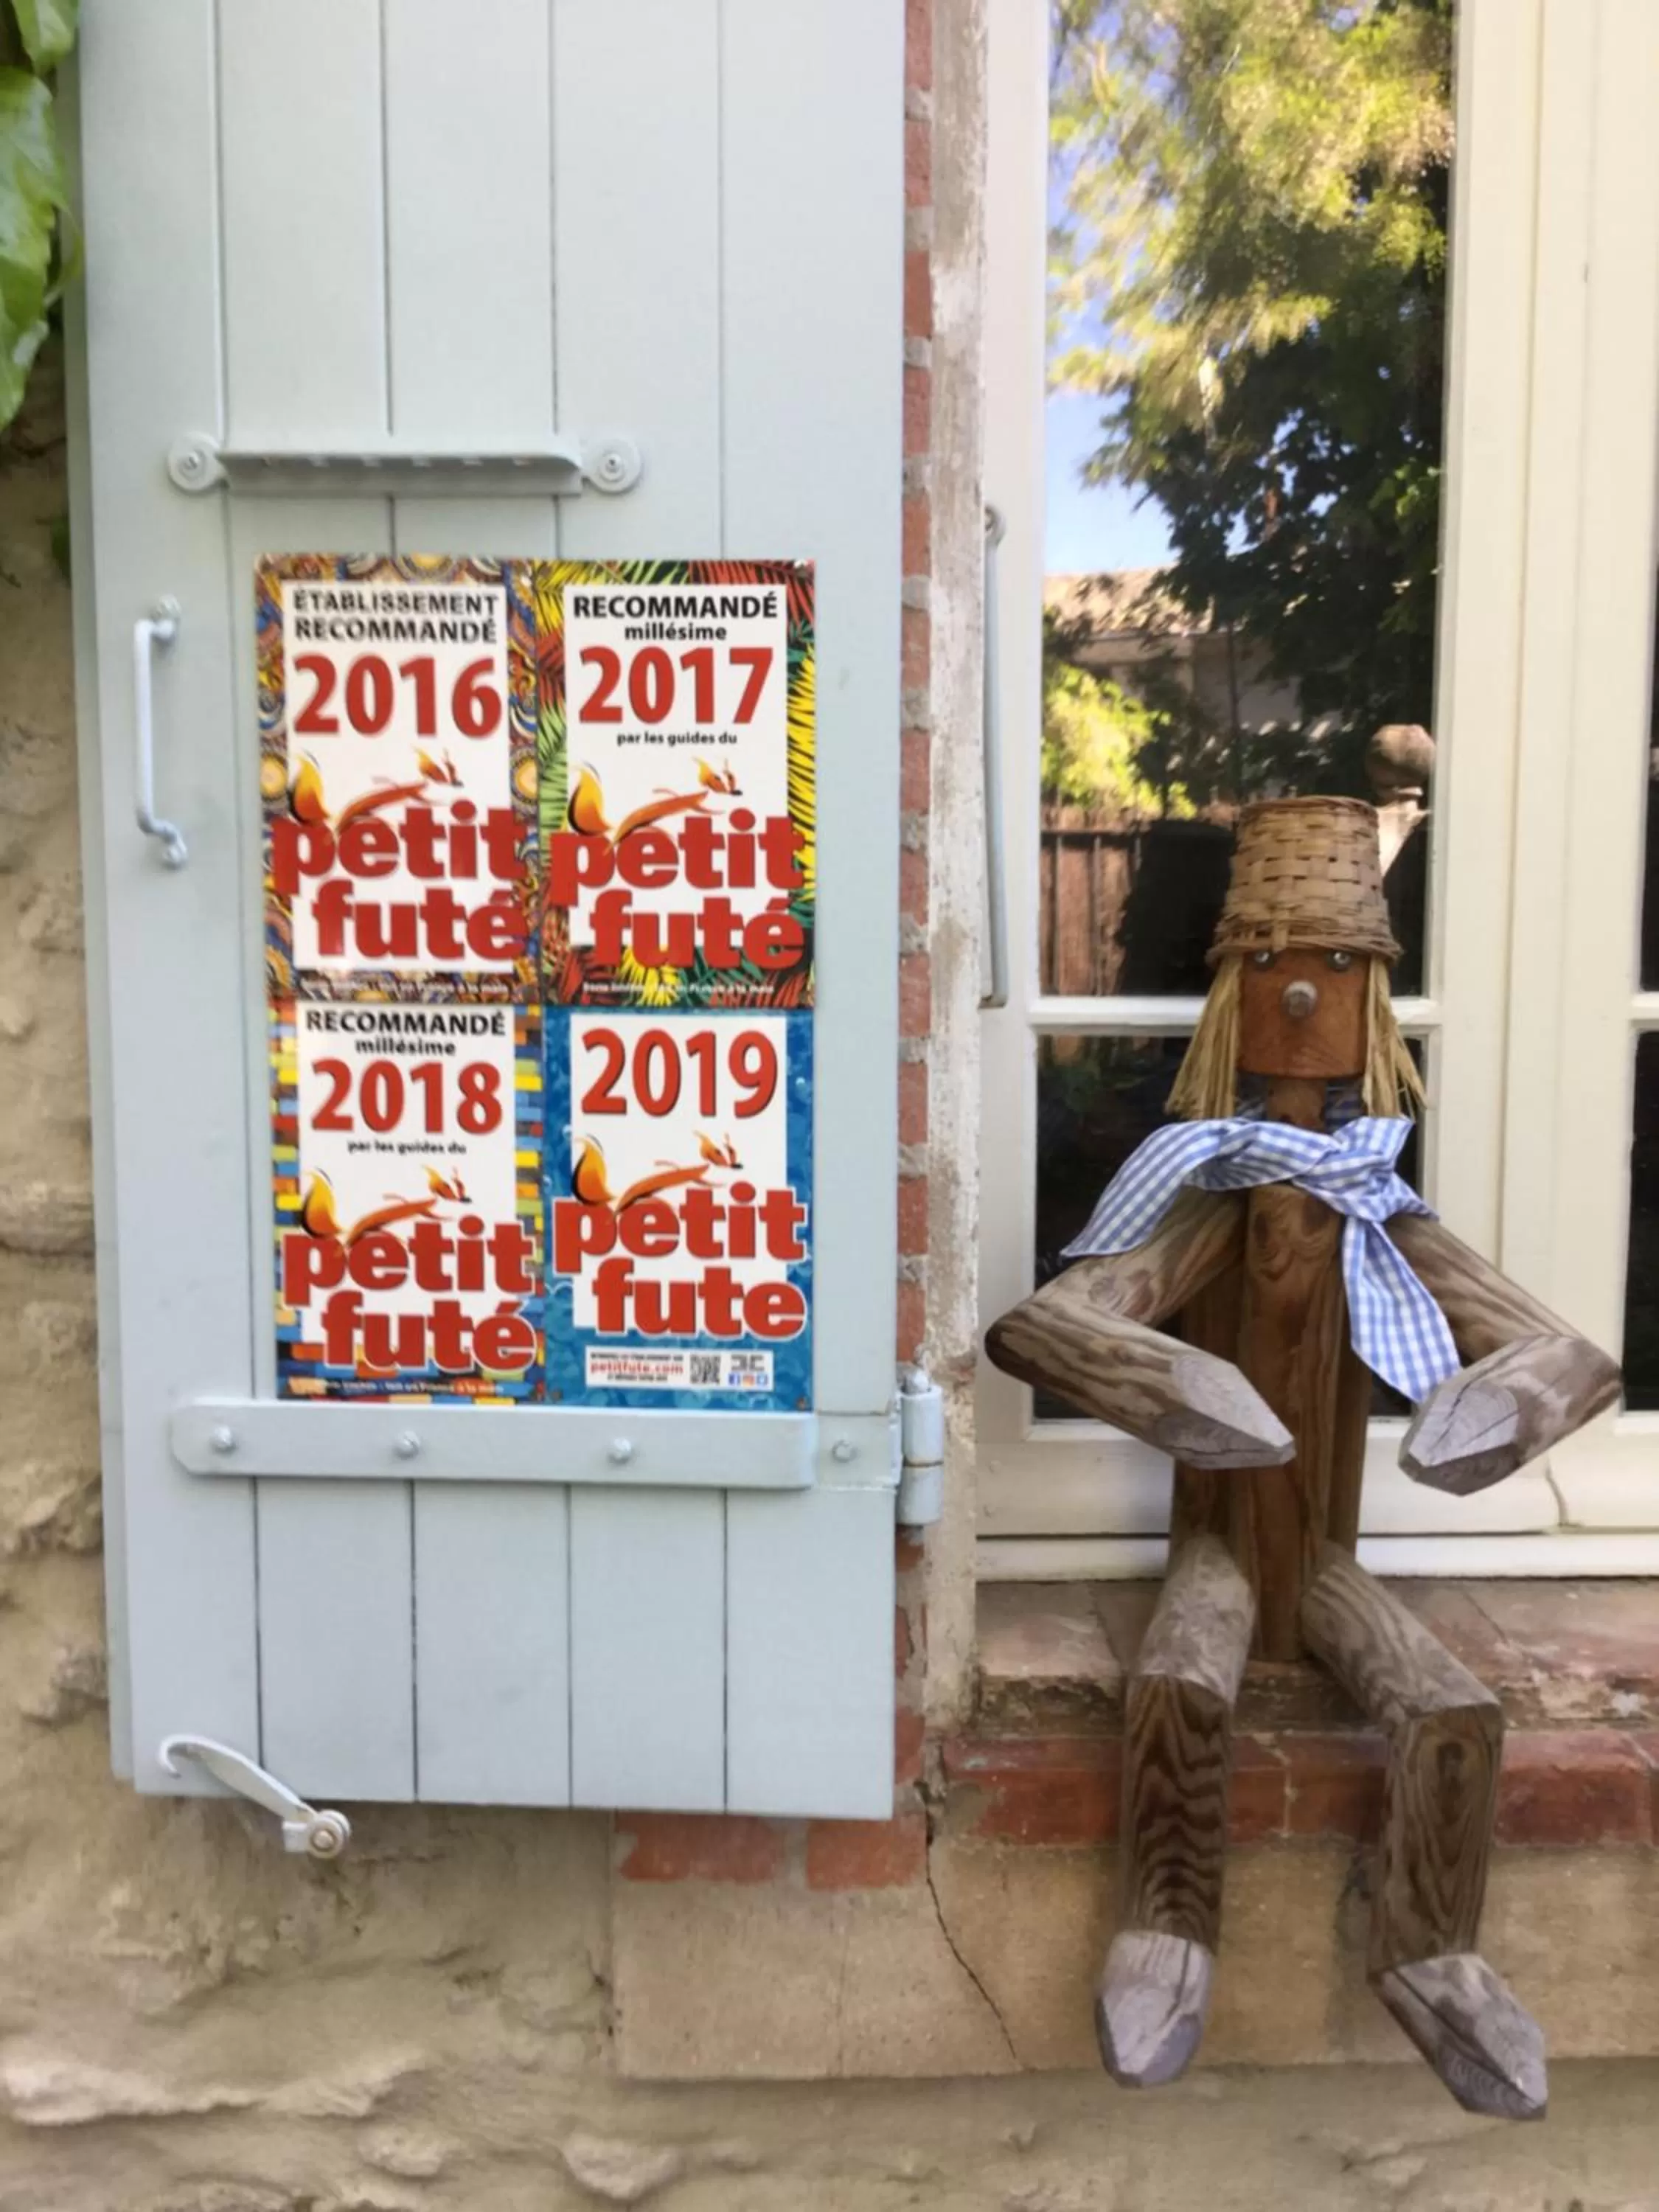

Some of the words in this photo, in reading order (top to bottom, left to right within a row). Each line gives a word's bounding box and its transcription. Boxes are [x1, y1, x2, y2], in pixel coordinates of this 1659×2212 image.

[294, 588, 498, 615] ÉTABLISSEMENT
[294, 619, 497, 644] RECOMMANDÉ
[574, 591, 777, 618] RECOMMANDÉ
[625, 622, 727, 640] millésime
[293, 653, 501, 737] 2016
[579, 646, 773, 724] 2017
[616, 734, 641, 746] par
[645, 731, 664, 744] les
[668, 731, 715, 746] guides
[719, 731, 737, 744] du
[271, 799, 528, 896] petit
[549, 807, 805, 908] petit
[312, 879, 527, 960] futé
[589, 888, 804, 969] futé
[306, 1010, 506, 1035] RECOMMANDÉ
[355, 1037, 456, 1056] millésime
[311, 1057, 503, 1135] 2018
[581, 1028, 778, 1119] 2019
[348, 1142, 371, 1154] par
[375, 1140, 394, 1152] les
[398, 1141, 445, 1155] guides
[448, 1142, 467, 1154] du
[283, 1214, 534, 1307] petit
[554, 1181, 804, 1273] petit
[321, 1290, 536, 1371] futé
[592, 1257, 804, 1337] fute
[590, 1361, 684, 1374] petitfute.com
